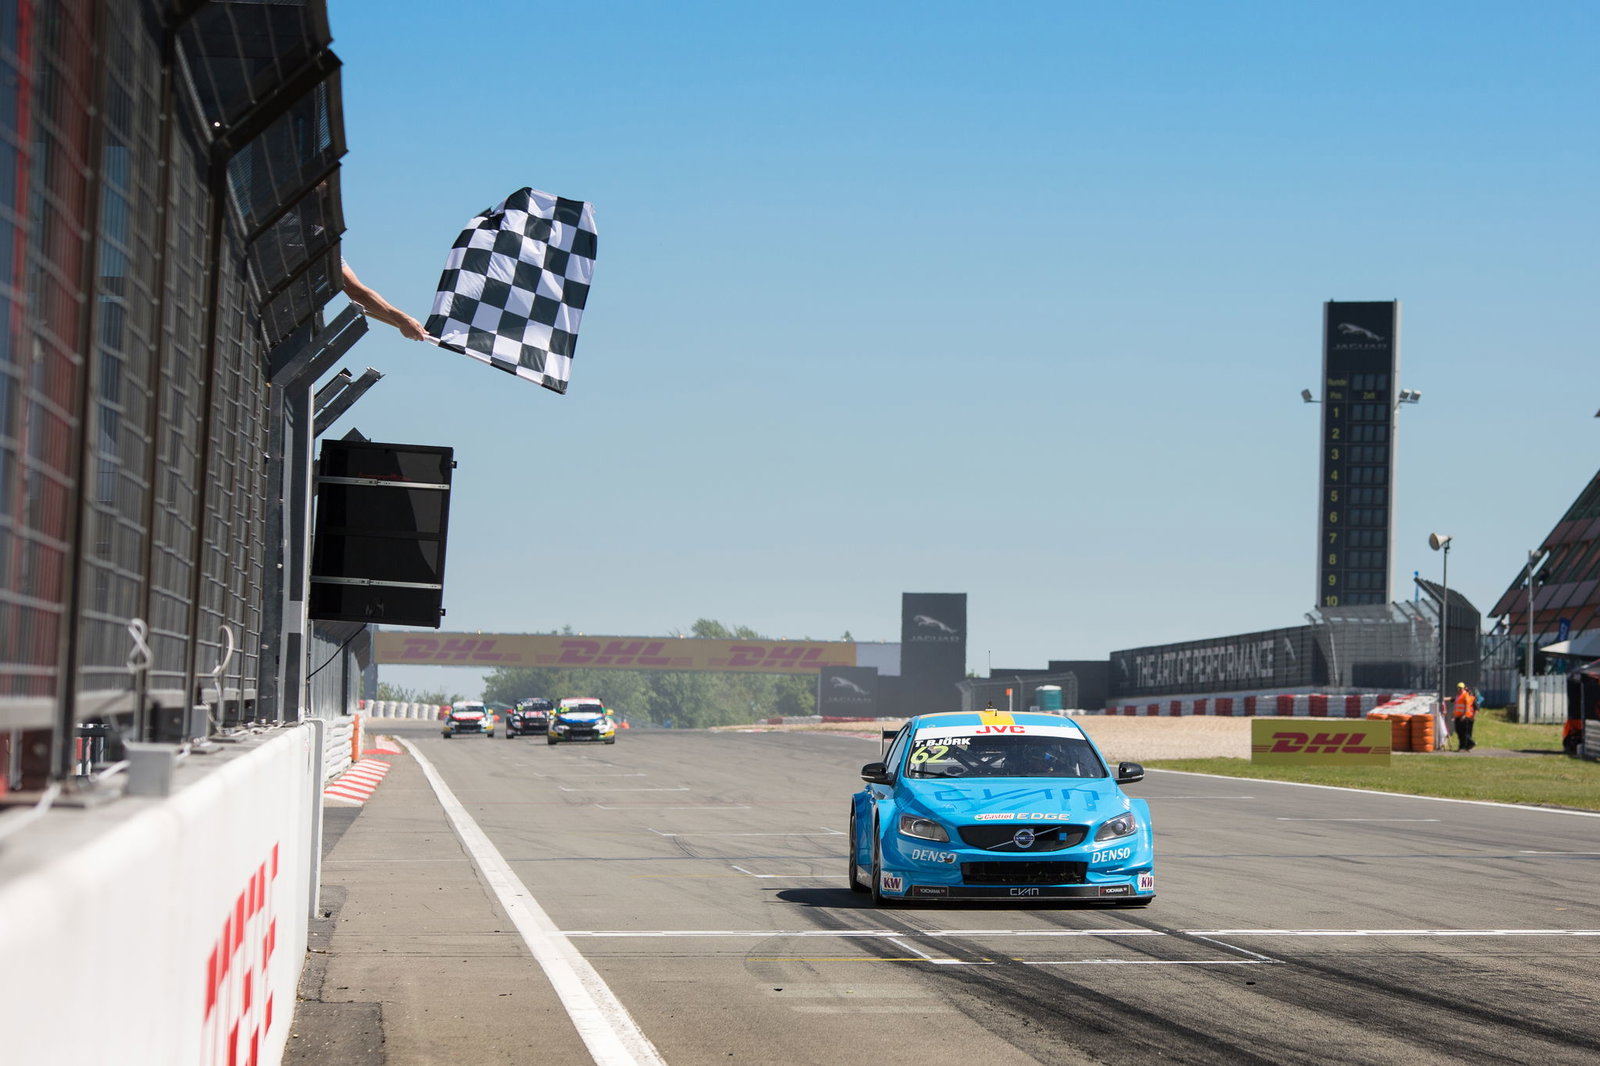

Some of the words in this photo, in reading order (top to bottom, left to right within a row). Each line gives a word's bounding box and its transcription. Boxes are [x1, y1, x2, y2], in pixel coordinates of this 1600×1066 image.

[1333, 407, 1339, 418] 1
[1332, 428, 1340, 439] 2
[1331, 448, 1339, 460] 3
[1331, 470, 1338, 481] 4
[1330, 490, 1338, 502] 5
[1330, 511, 1337, 523] 6
[1329, 533, 1337, 544] 7
[1328, 554, 1336, 565] 8
[1328, 575, 1336, 586] 9
[1325, 596, 1338, 606] 10
[401, 638, 500, 660] DHL
[559, 640, 671, 665] DHL
[727, 645, 827, 668] DHL
[1136, 655, 1155, 688] THE
[1156, 652, 1176, 686] ART
[1177, 649, 1192, 684] OF
[1192, 640, 1274, 683] PERFORMANCE
[976, 725, 1025, 734] JVC
[1271, 732, 1373, 754] DHL
[911, 745, 950, 764] 62
[1017, 813, 1070, 821] EDGE
[911, 849, 957, 864] DENSO
[1092, 847, 1131, 864] DENSO
[883, 877, 902, 889] KW
